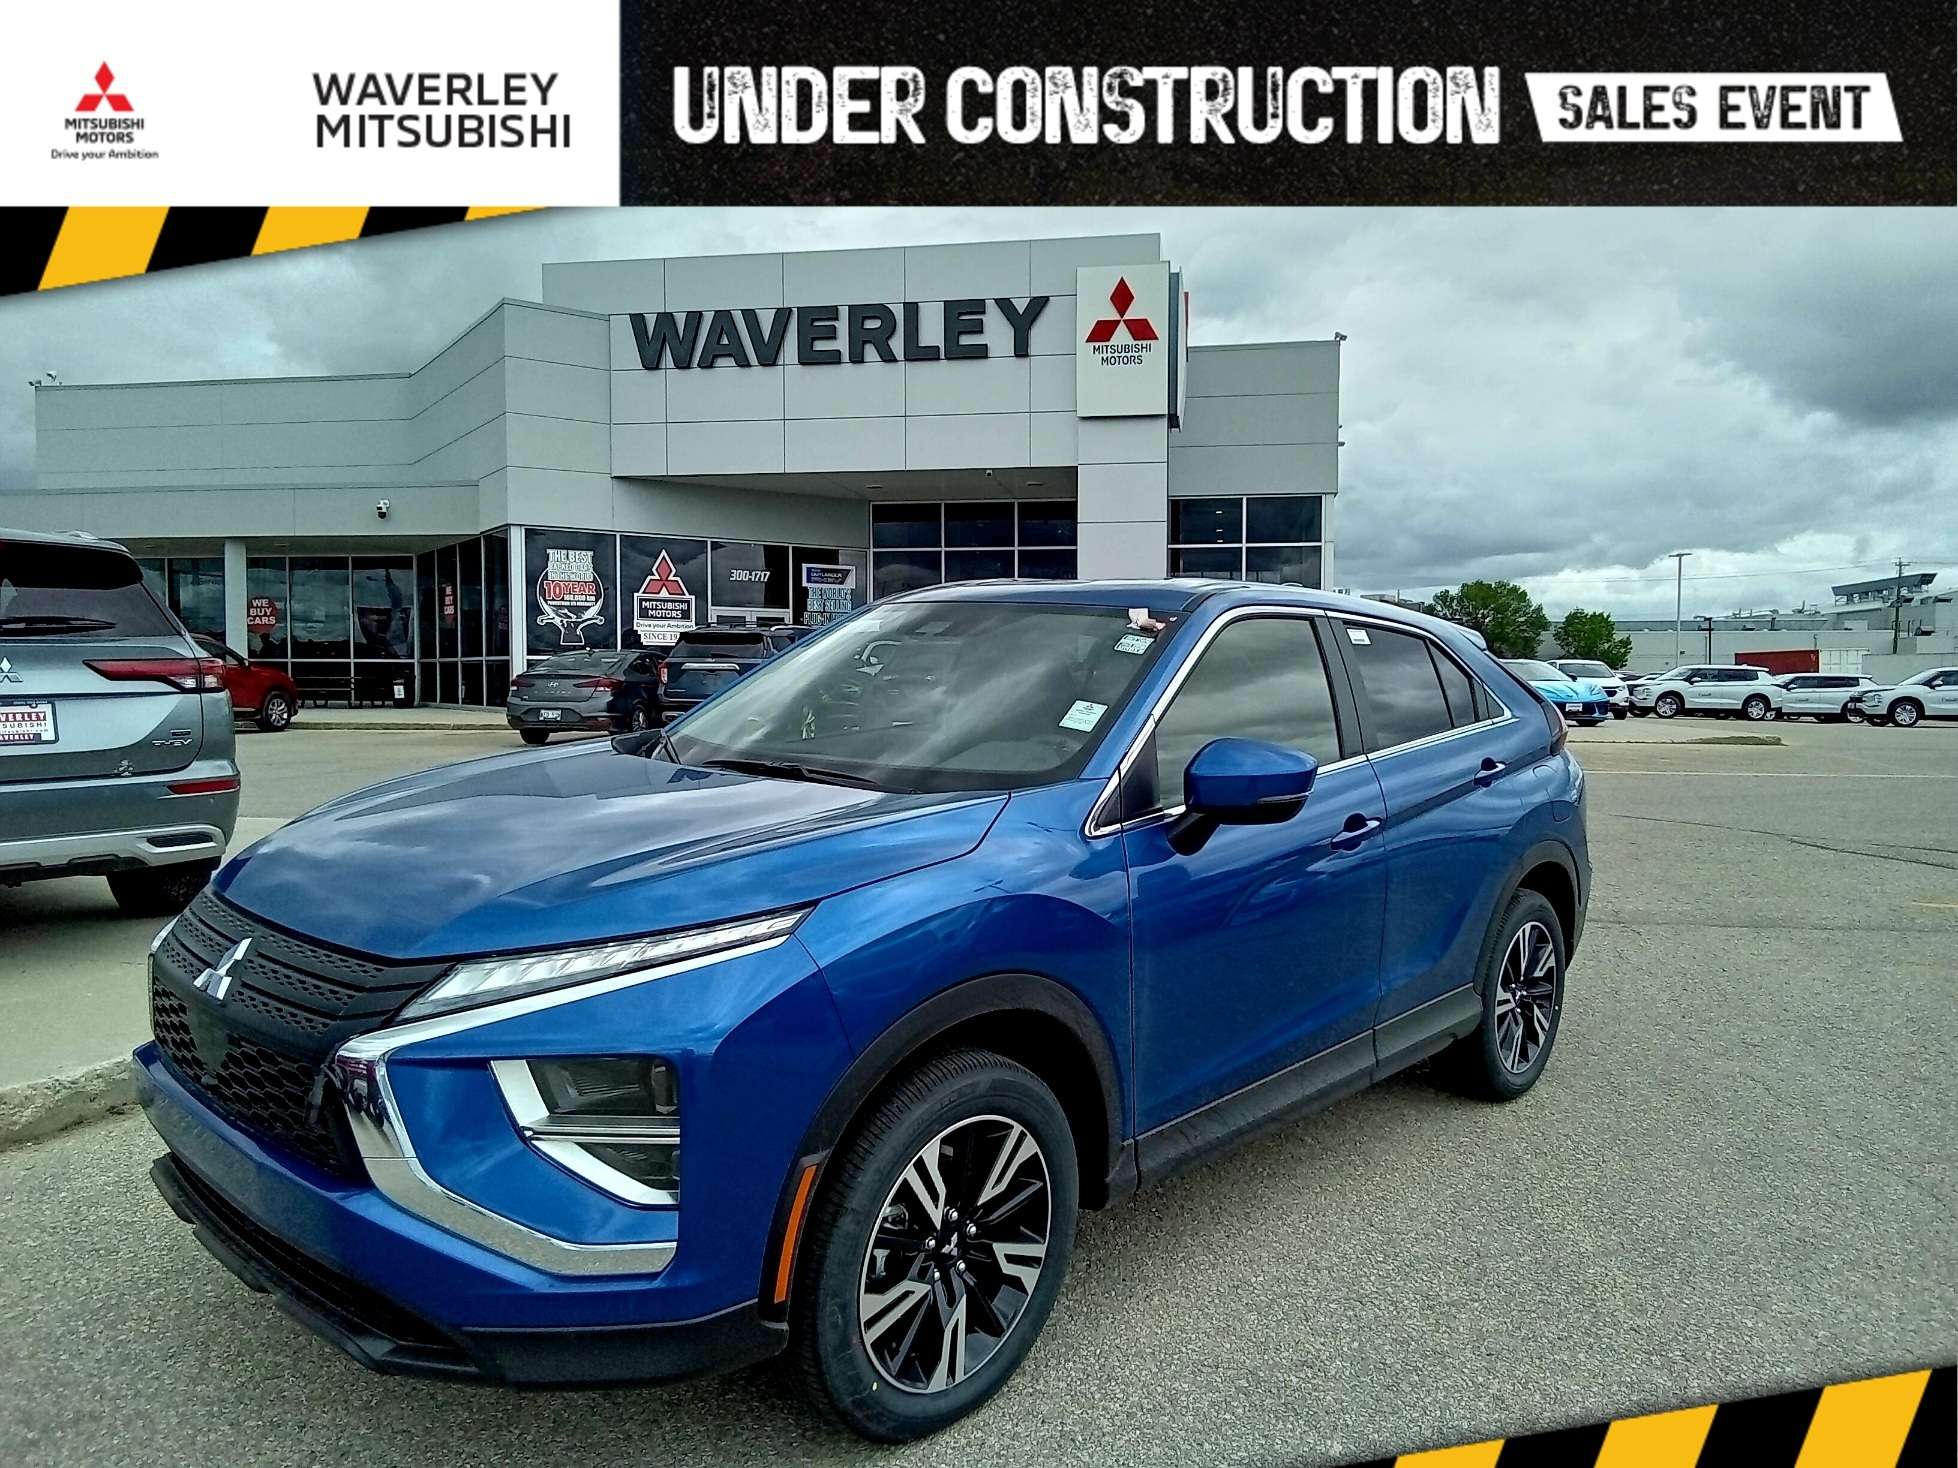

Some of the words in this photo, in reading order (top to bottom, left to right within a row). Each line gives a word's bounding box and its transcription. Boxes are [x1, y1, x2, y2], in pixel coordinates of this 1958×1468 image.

[629, 296, 1050, 370] WAVERLEY
[1092, 343, 1152, 356] MITSUBISHI
[1101, 355, 1143, 366] MOTORS
[547, 549, 567, 563] THE
[567, 550, 593, 564] BEST
[730, 569, 771, 582] 300-1717
[544, 581, 563, 600] 10
[562, 582, 596, 595] YEAR
[252, 599, 270, 607] WE
[642, 601, 688, 610] MITSUBISHI
[807, 599, 824, 611] BEST
[249, 607, 273, 616] BUY
[648, 609, 682, 618] MOTORS
[247, 616, 276, 625] CARS
[643, 632, 667, 640] SINCE
[0, 711, 45, 721] VERLEY
